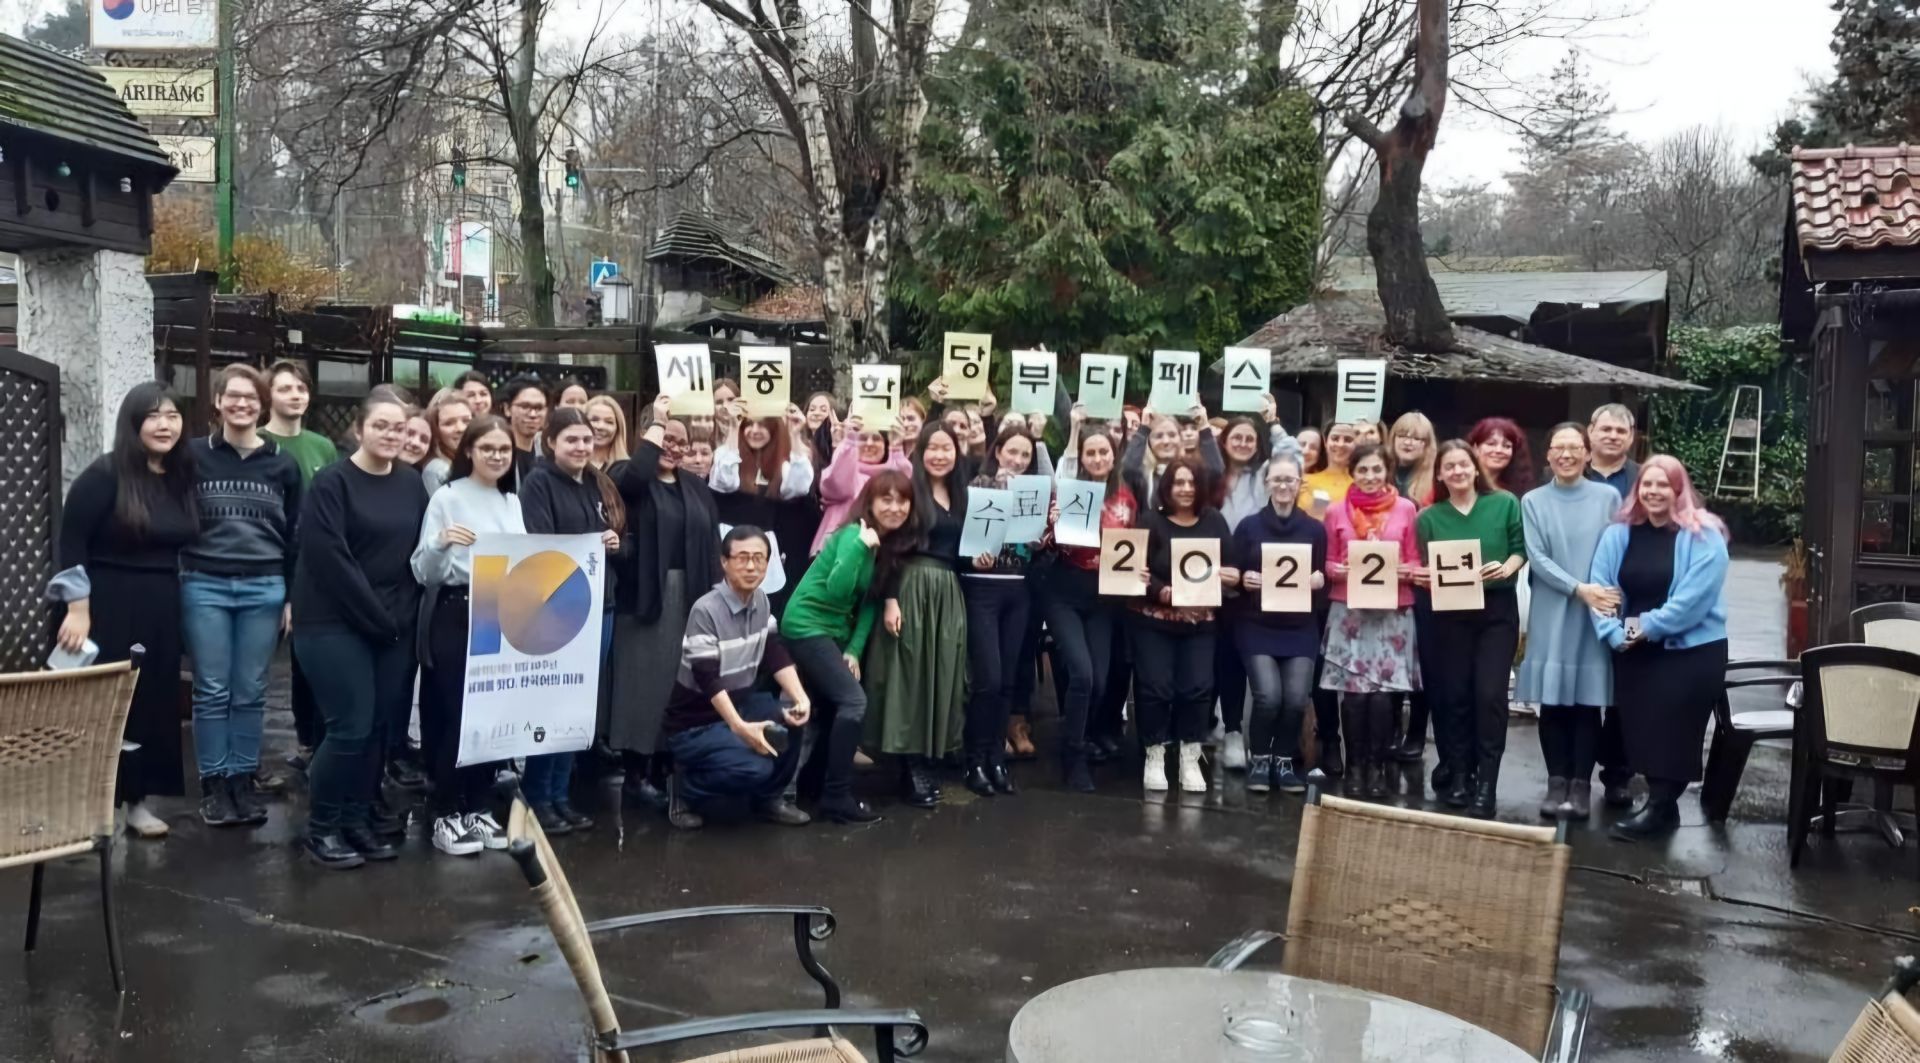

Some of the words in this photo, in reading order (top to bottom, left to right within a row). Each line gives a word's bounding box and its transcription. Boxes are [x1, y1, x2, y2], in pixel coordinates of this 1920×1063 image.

[121, 82, 205, 102] ARIRANG
[667, 356, 705, 392] 세
[747, 359, 783, 395] 종
[949, 344, 986, 379] 당
[1018, 362, 1050, 394] 부
[1229, 360, 1263, 391] 스
[859, 375, 896, 411] 학
[1085, 365, 1122, 400] 다
[1158, 362, 1192, 396] 페
[1343, 371, 1377, 403] 트
[972, 499, 1005, 539] 수
[1011, 489, 1043, 518] 료
[1063, 490, 1095, 529] 식
[1111, 539, 1136, 572] 2
[1178, 550, 1213, 583] 0
[1274, 555, 1299, 589] 2
[1360, 552, 1386, 586] 2
[1436, 551, 1476, 588] 년
